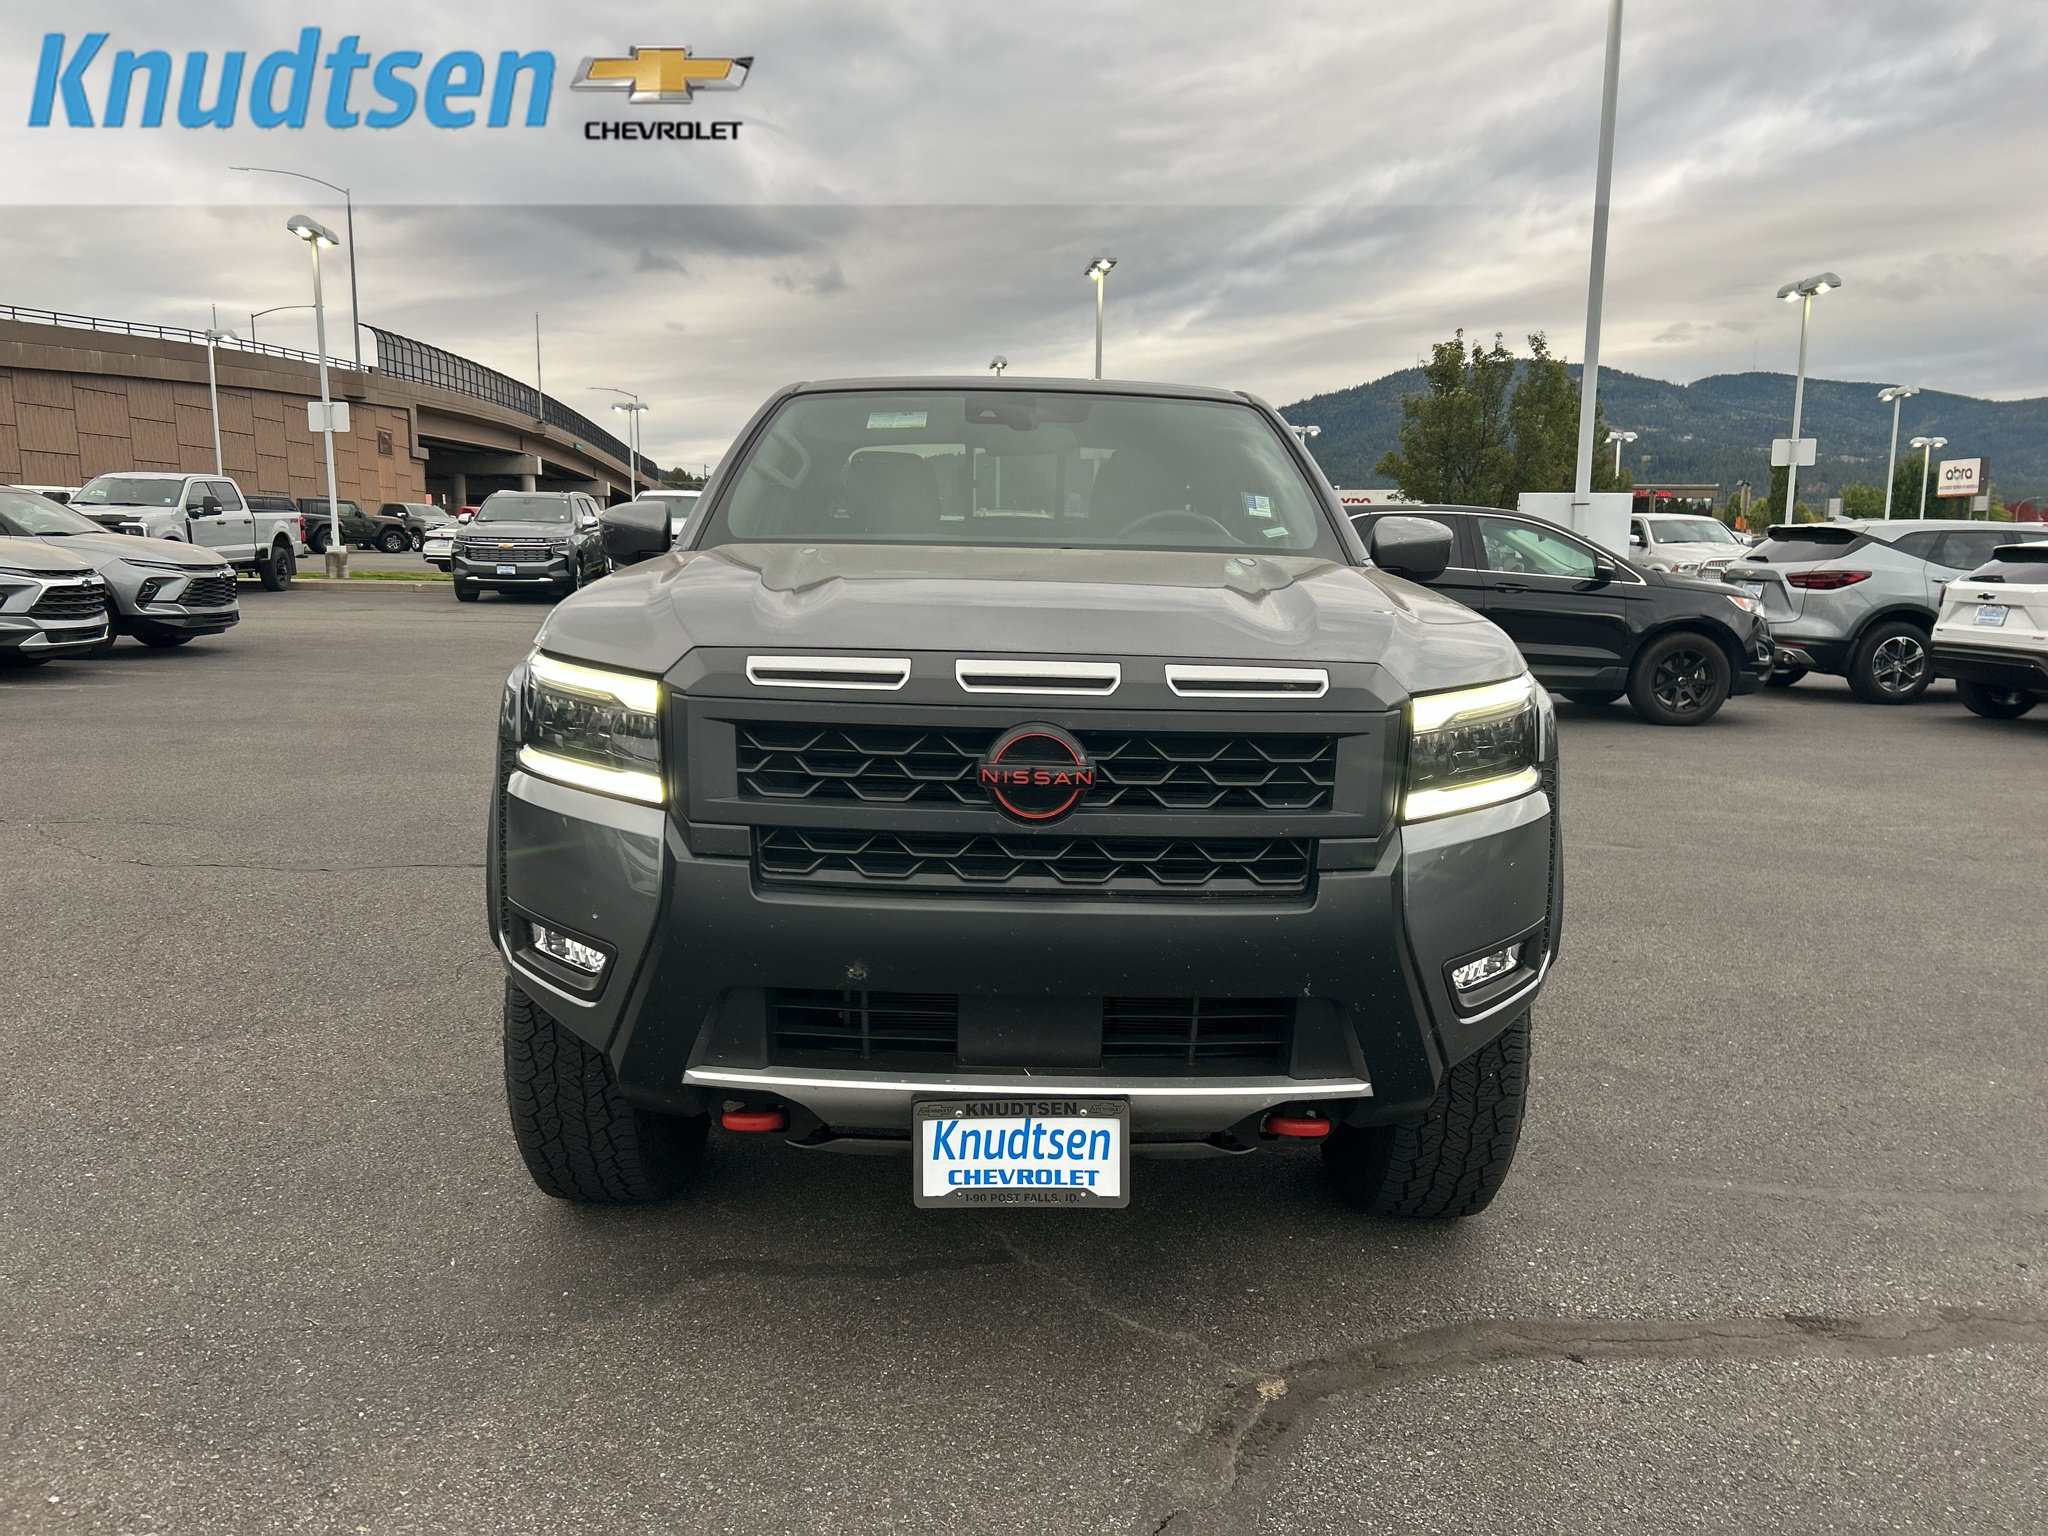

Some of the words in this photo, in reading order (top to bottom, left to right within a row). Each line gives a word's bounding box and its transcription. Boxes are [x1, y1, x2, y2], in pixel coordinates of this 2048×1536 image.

[1946, 466, 1972, 480] abra
[982, 768, 1092, 784] NISSAN
[965, 1102, 1077, 1117] KNUDTSEN
[933, 1118, 1110, 1161] Knudtsen
[948, 1169, 1099, 1186] CHEVROLET
[965, 1193, 987, 1203] I-90
[991, 1193, 1020, 1204] POST
